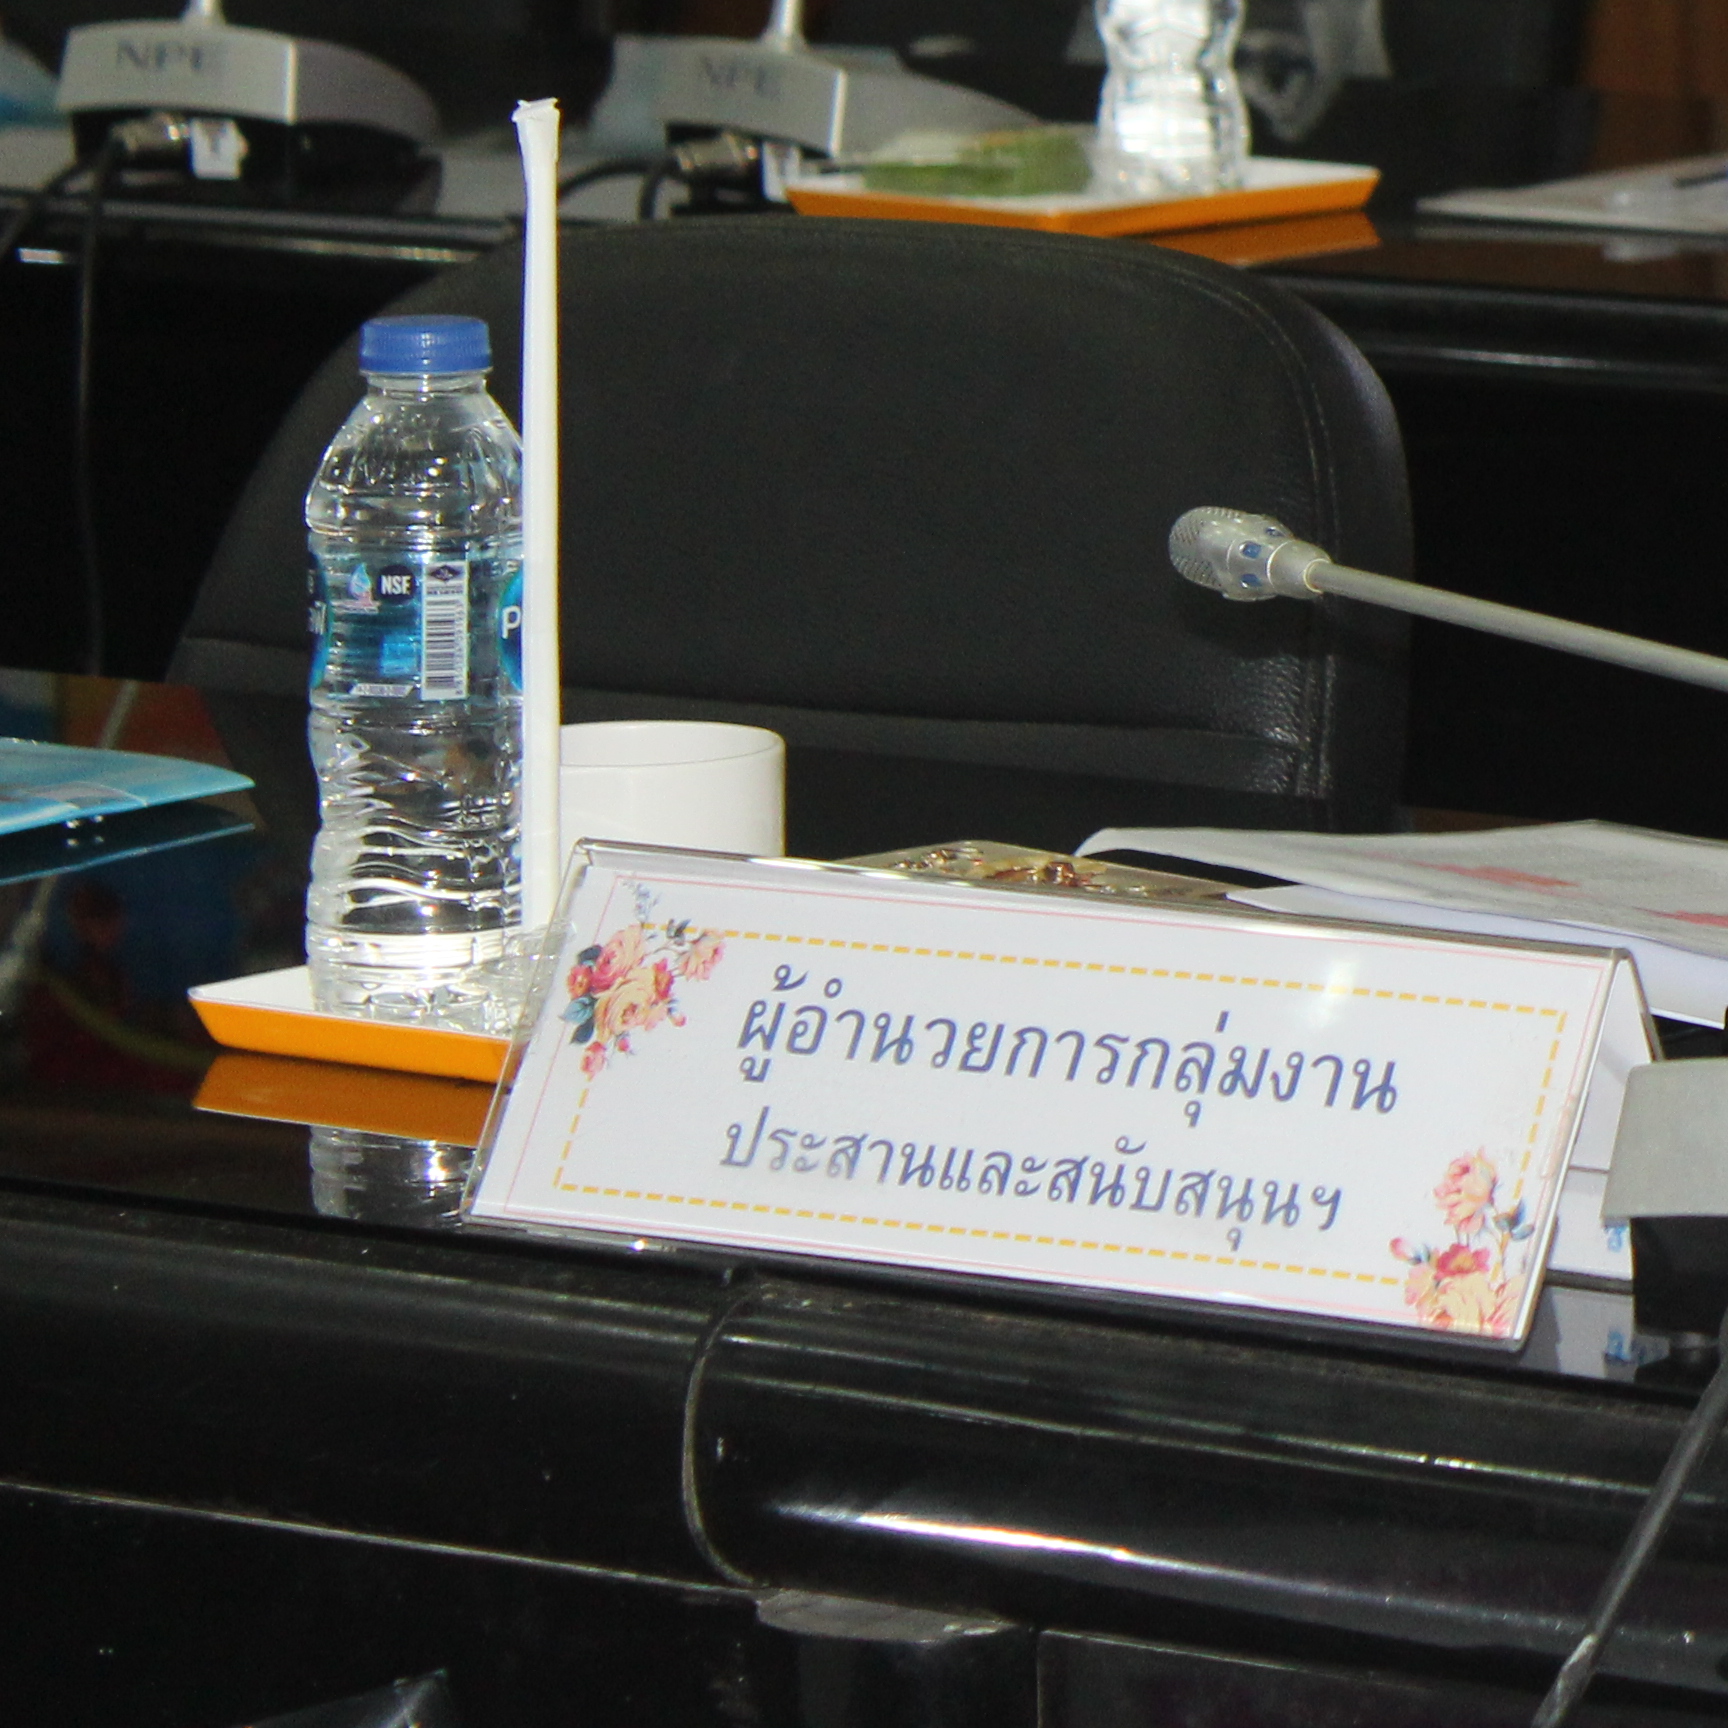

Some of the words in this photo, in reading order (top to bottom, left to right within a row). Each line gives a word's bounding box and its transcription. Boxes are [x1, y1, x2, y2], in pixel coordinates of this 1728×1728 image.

[381, 574, 411, 596] NSF
[735, 962, 1399, 1127] ผู้อำนวยการกลุ่มงาน
[717, 1108, 1344, 1252] ประสานและสนับสนุนฯ
